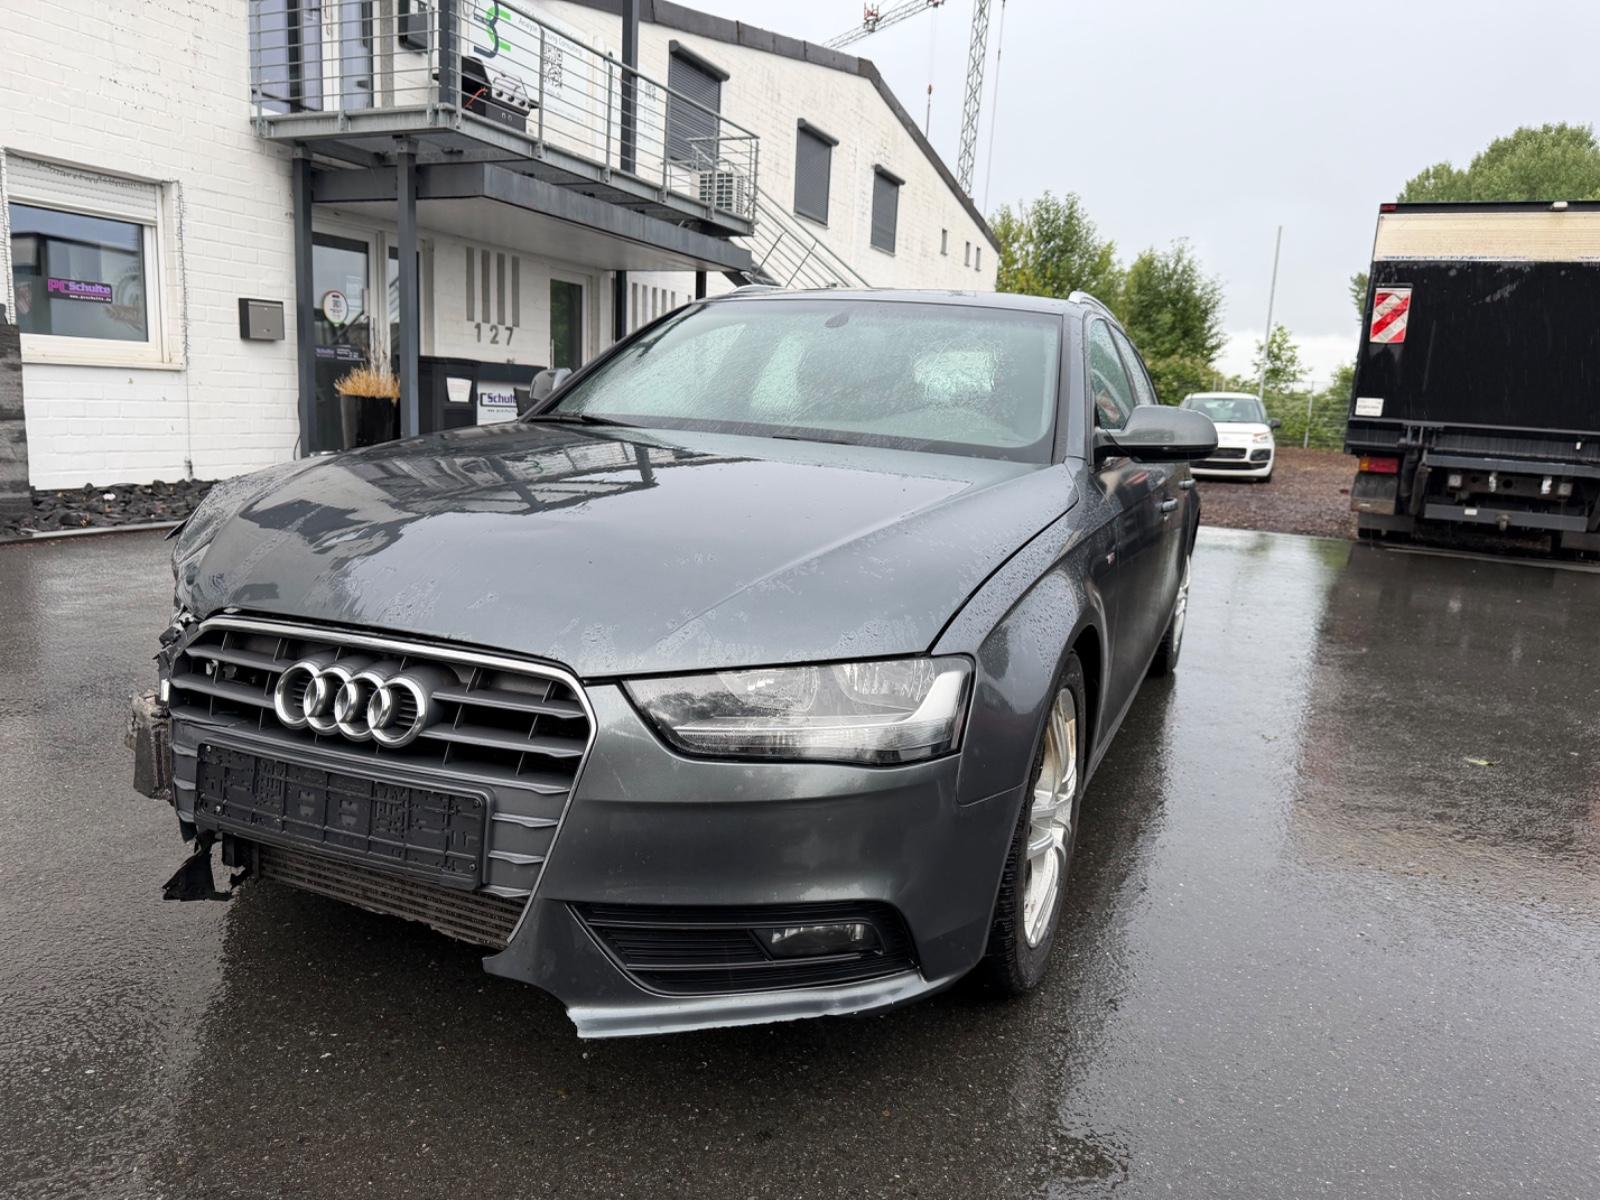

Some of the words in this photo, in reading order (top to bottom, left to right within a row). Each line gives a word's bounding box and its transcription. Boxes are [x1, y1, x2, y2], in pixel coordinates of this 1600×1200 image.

[68, 281, 111, 293] Schulte
[474, 322, 514, 346] 127
[488, 392, 517, 404] Schult
